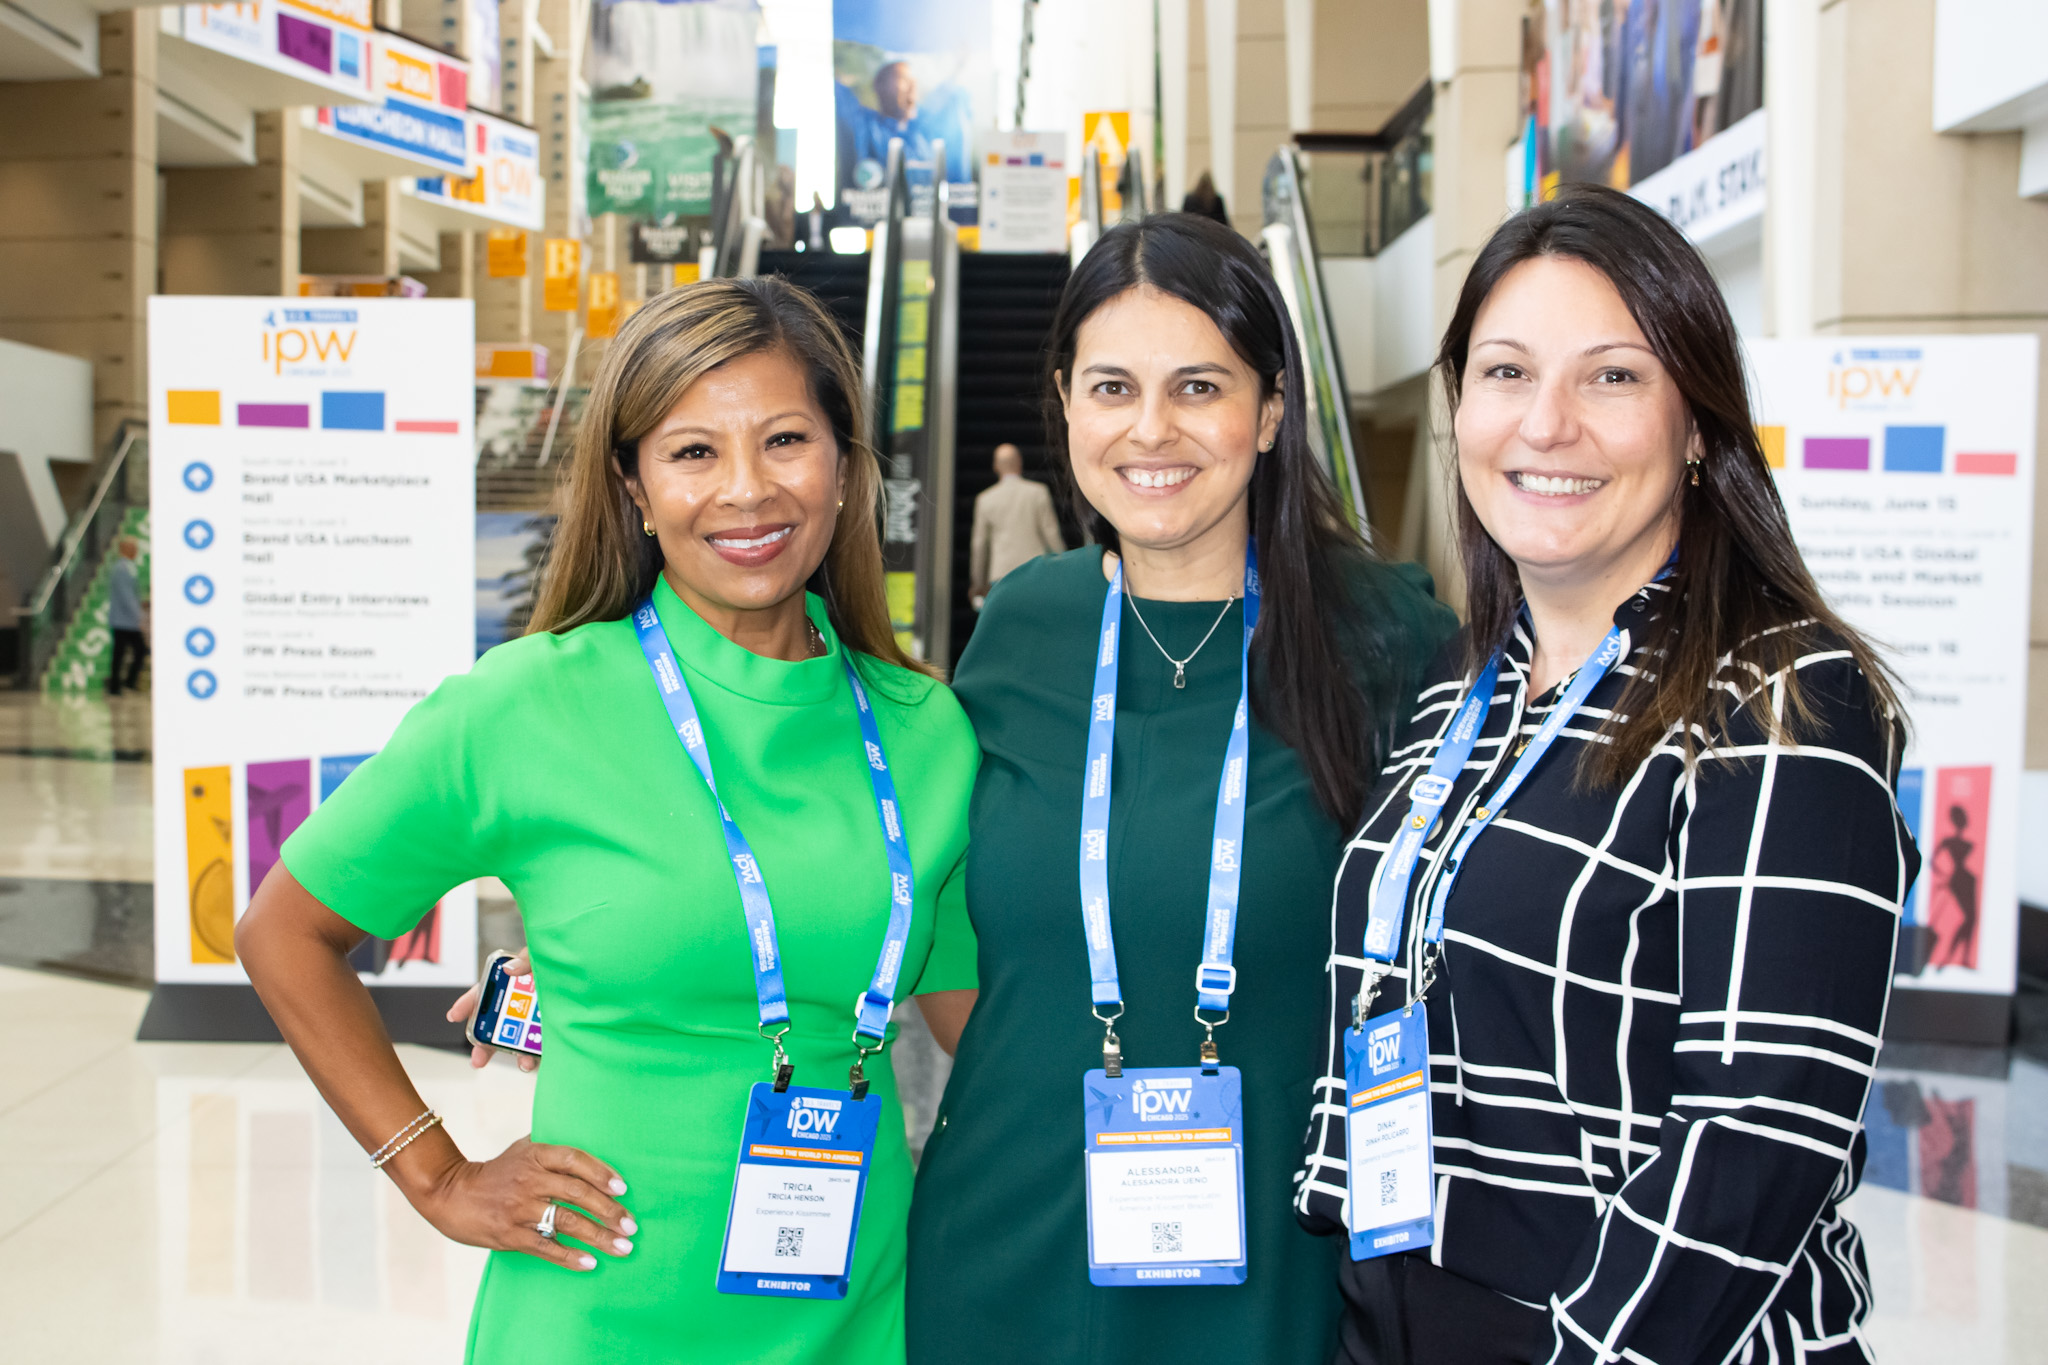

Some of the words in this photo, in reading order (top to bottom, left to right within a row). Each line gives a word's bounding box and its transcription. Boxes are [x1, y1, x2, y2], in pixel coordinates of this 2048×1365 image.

[262, 328, 358, 376] ipw
[1827, 366, 1921, 410] ipw
[242, 472, 290, 486] Brand
[294, 472, 327, 486] USA
[333, 472, 431, 490] Marketplace
[242, 491, 273, 504] Hall
[1884, 496, 1930, 511] June
[242, 532, 291, 546] Brand
[295, 532, 328, 546] USA
[334, 533, 412, 547] Luncheon
[242, 551, 273, 564] Hall
[1861, 545, 1904, 561] USA
[1910, 546, 1979, 562] Global
[1870, 569, 1905, 584] and
[1913, 569, 1982, 586] Market
[243, 592, 295, 606] Global
[301, 592, 342, 609] Entry
[347, 592, 430, 606] Interviews
[1881, 593, 1957, 609] Session
[243, 645, 275, 659] IPW
[282, 645, 324, 659] Press
[328, 645, 376, 659] Room
[1597, 635, 1620, 666] ipw
[654, 658, 674, 694] EXPRESS
[659, 652, 681, 691] AMERICAN
[243, 686, 276, 700] IPW
[282, 686, 324, 700] Press
[1093, 694, 1107, 722] ipw
[1452, 696, 1477, 744] AMERICAN
[1462, 701, 1483, 741] EXPRESS
[678, 719, 698, 750] ipw
[1083, 830, 1099, 861] ipw
[1221, 839, 1238, 872] ipw
[733, 853, 756, 884] ipw
[897, 873, 912, 906] ipw
[1210, 909, 1223, 962] AMERICAN
[1219, 909, 1230, 954] EXPRESS
[1372, 918, 1389, 954] ipw
[754, 927, 768, 972] EXPRESS
[760, 919, 775, 970] AMERICAN
[876, 939, 895, 989] AMERICAN
[1368, 1034, 1400, 1076] ipw
[1133, 1090, 1192, 1122] ipw
[787, 1107, 840, 1138] ipw
[1147, 1113, 1174, 1122] CHICAGO
[1174, 1113, 1188, 1121] 2025
[1377, 1120, 1396, 1132] DINAH
[1153, 1133, 1181, 1141] WORLD
[1182, 1132, 1194, 1140] TO
[1365, 1137, 1380, 1147] DINAH
[785, 1148, 798, 1157] THE
[798, 1150, 822, 1160] WORLD
[822, 1152, 831, 1160] TO
[831, 1153, 860, 1163] AMERICA
[1127, 1166, 1201, 1177] ALESSANDRA
[783, 1182, 813, 1192] TRICIA
[1121, 1178, 1180, 1187] ALESSANDRA
[1183, 1176, 1208, 1185] UENO
[768, 1192, 791, 1201] TRICIA
[794, 1194, 825, 1202] HENSON
[756, 1207, 794, 1217] Experience
[1374, 1231, 1409, 1249] EXHIBITOR
[1136, 1268, 1201, 1280] EXHIBITOR
[757, 1279, 811, 1292] EXHIBITOR
